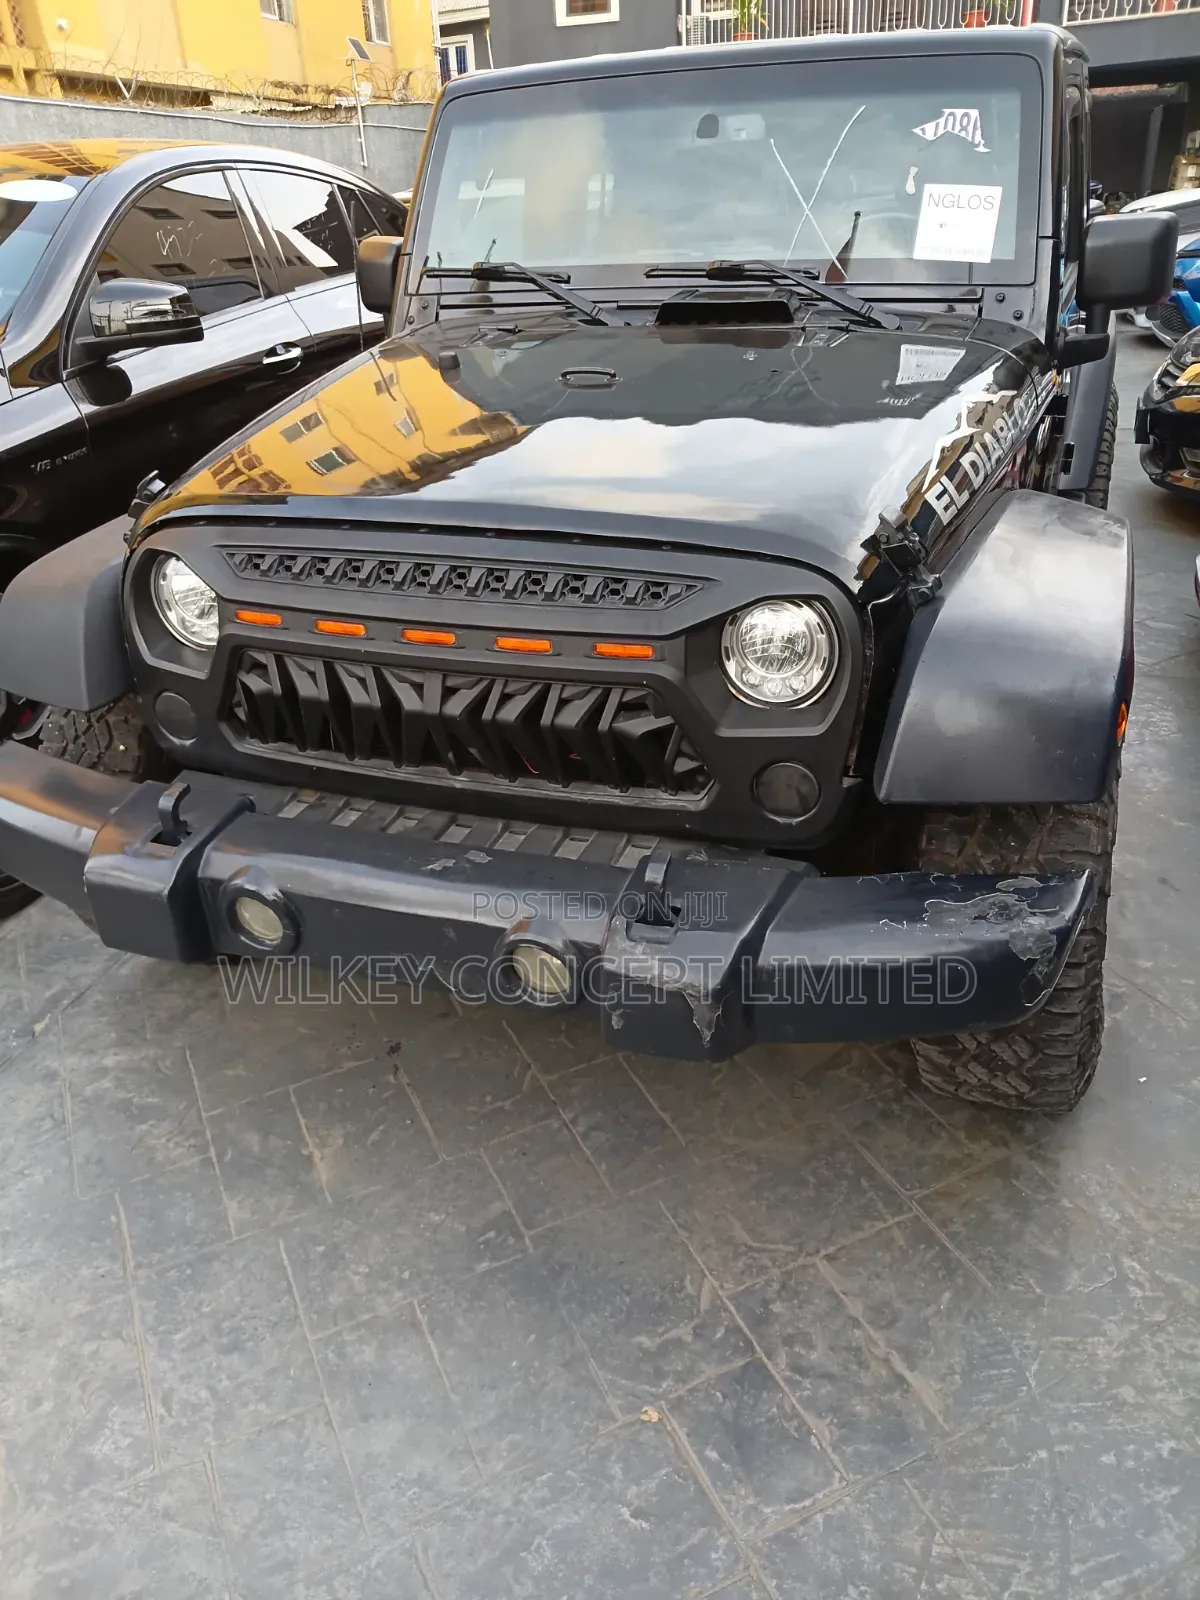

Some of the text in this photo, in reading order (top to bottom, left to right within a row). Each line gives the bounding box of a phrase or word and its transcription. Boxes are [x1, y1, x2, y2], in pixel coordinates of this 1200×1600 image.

[927, 191, 996, 210] NGLOS
[924, 397, 1028, 526] EL DIABLO
